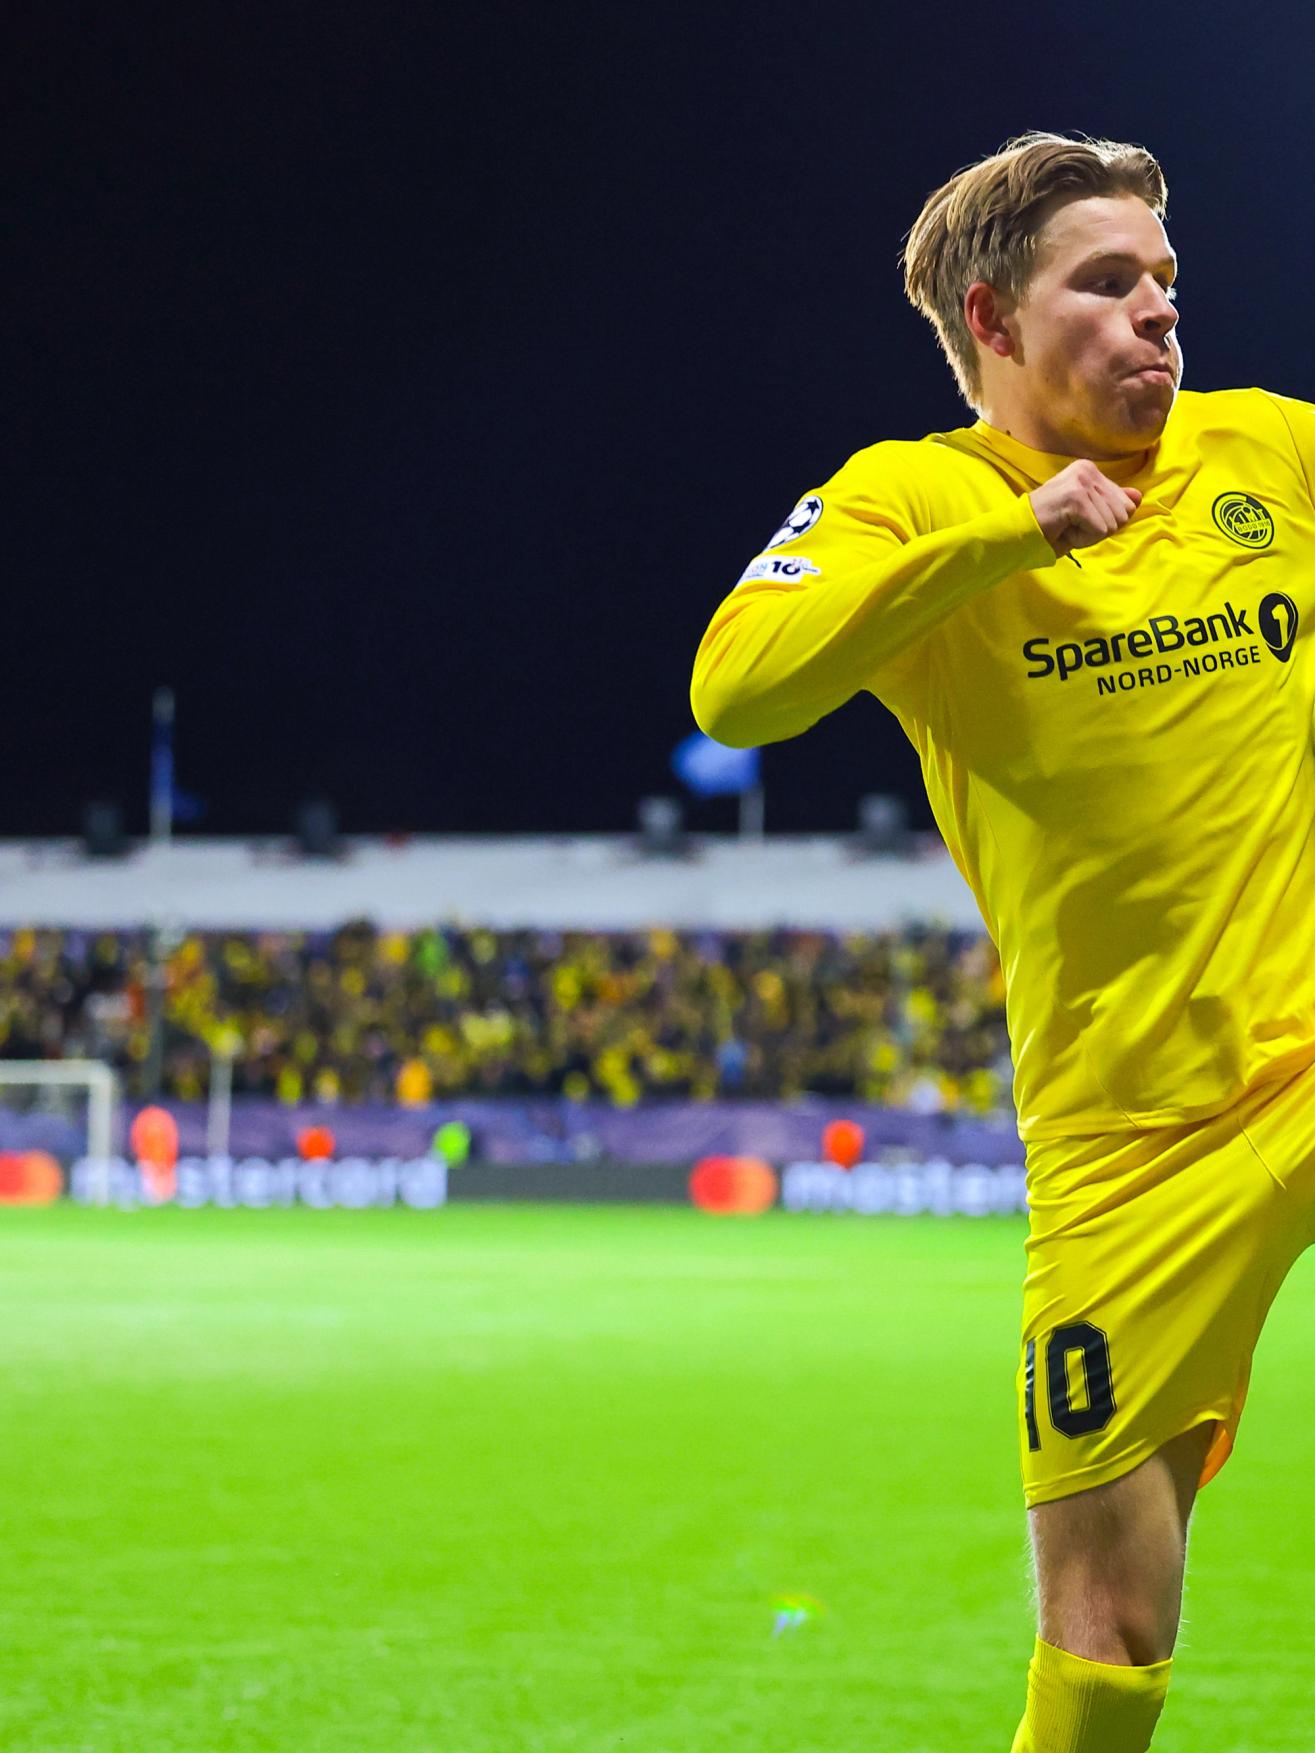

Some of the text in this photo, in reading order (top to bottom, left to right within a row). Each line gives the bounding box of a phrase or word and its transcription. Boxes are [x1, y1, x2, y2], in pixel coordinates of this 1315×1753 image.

[1022, 601, 1254, 681] SpareBank
[1097, 646, 1261, 695] NORD-NORGE
[781, 1157, 1029, 1217] master
